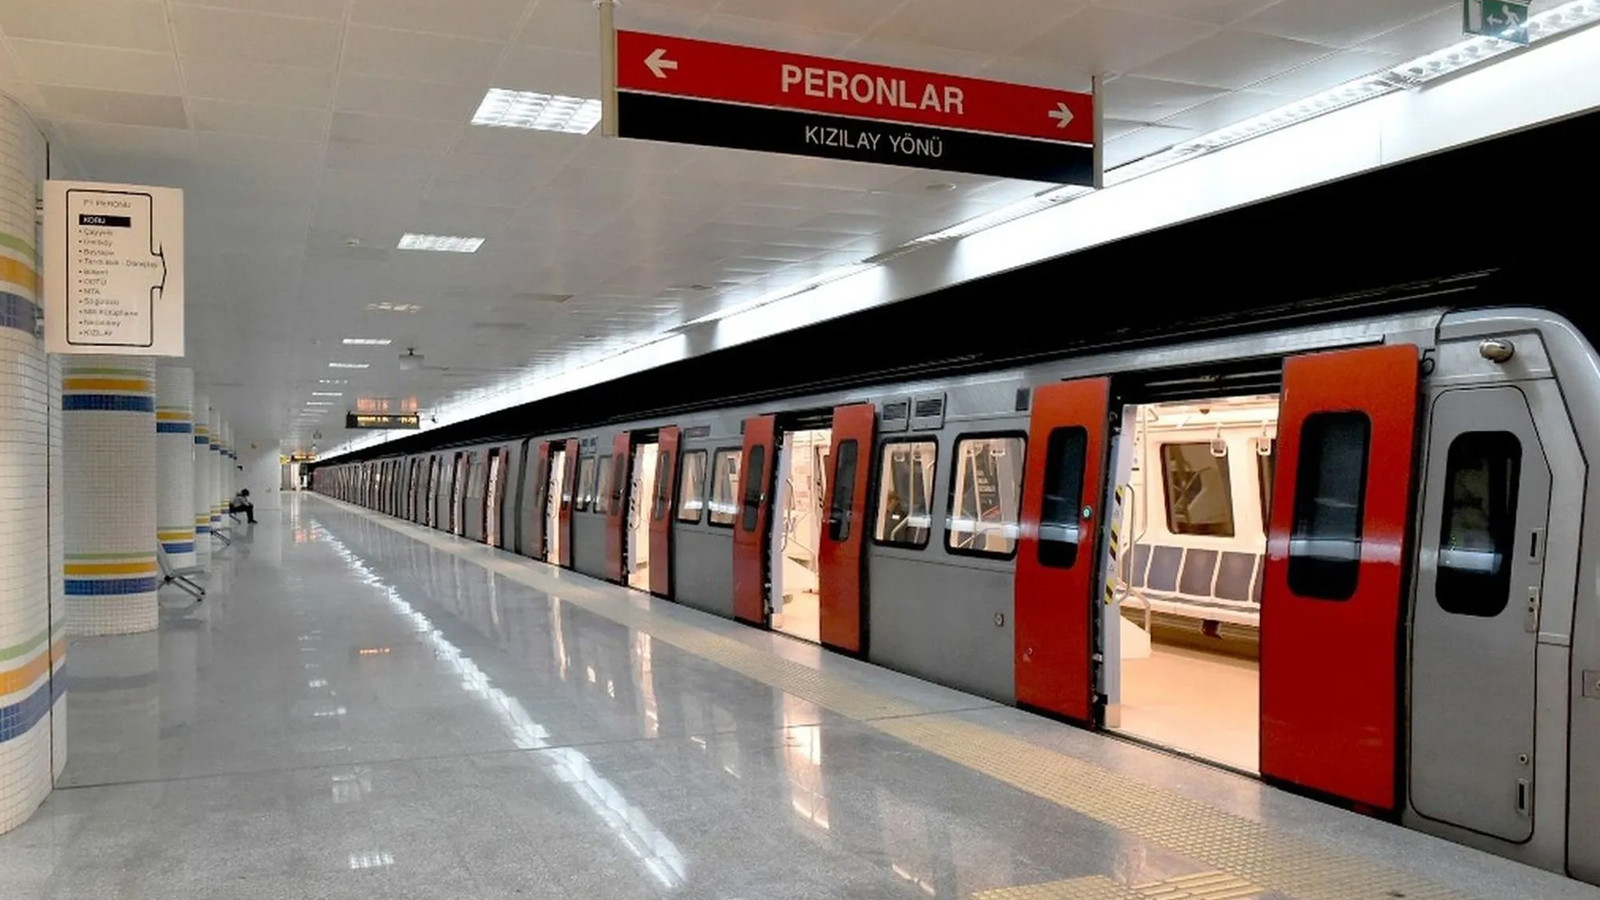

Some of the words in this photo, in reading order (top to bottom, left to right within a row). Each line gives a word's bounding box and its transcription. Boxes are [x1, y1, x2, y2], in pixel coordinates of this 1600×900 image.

[781, 64, 964, 115] PERONLAR
[805, 125, 881, 151] KIZILAY
[889, 132, 943, 158] YÖNÜ
